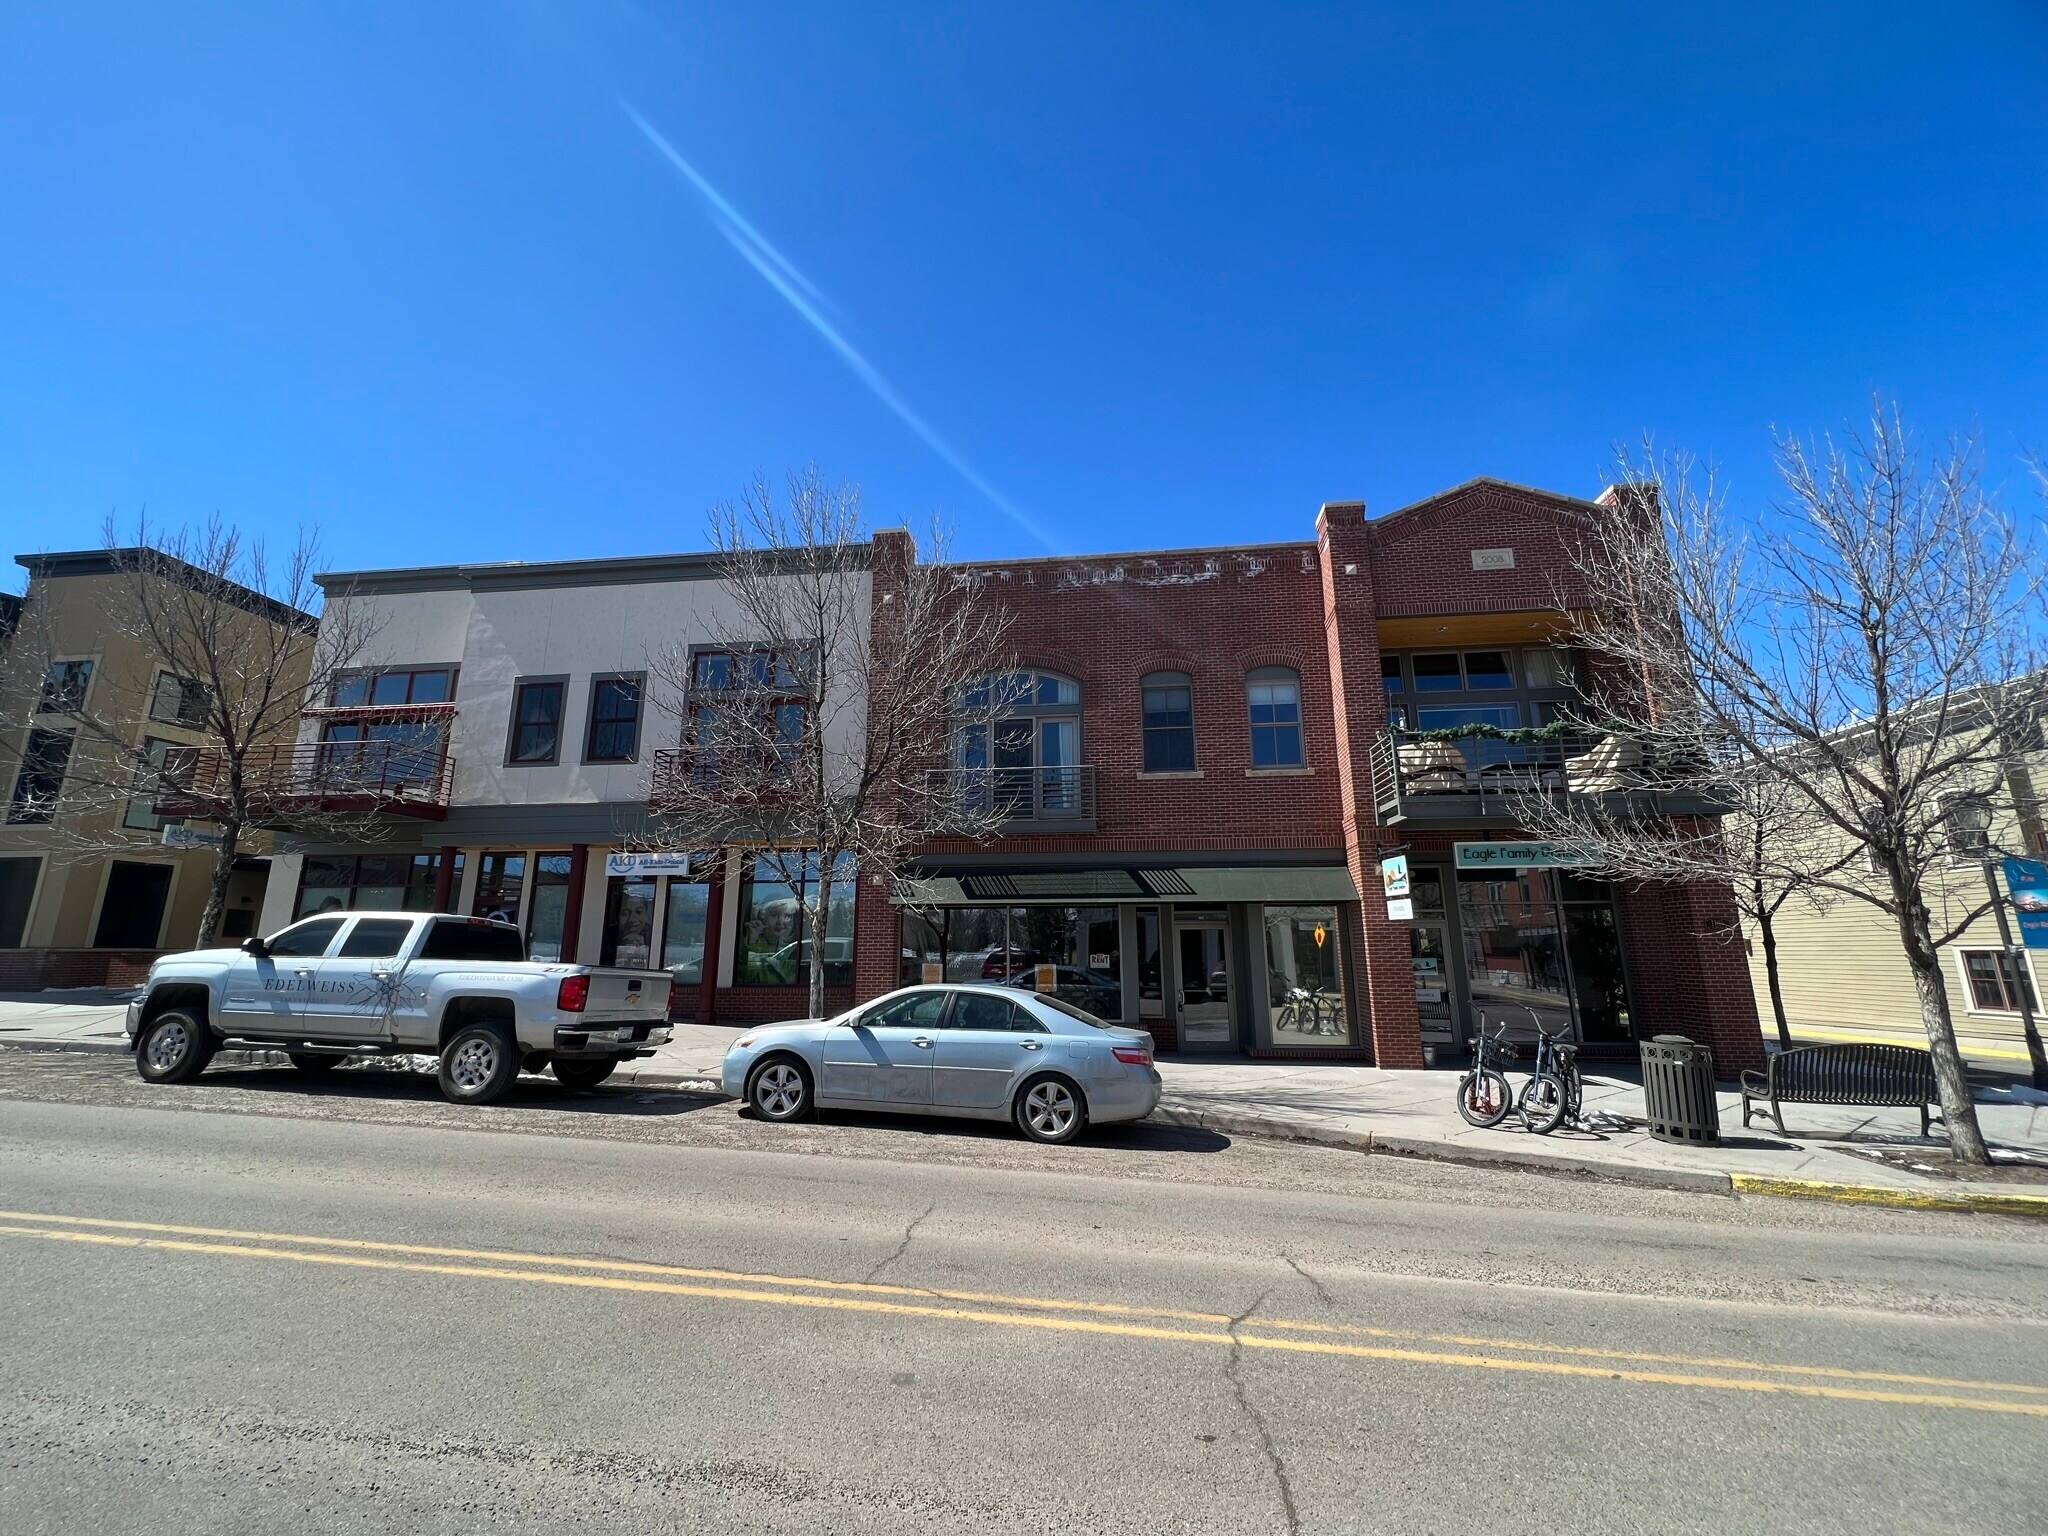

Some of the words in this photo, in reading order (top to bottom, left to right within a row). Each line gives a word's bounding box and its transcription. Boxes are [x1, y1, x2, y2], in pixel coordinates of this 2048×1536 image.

[1481, 555, 1504, 564] 2008
[609, 855, 636, 866] AKD
[1463, 848, 1497, 862] Eagle
[1500, 847, 1538, 861] Family
[264, 979, 355, 993] EDELWEISS
